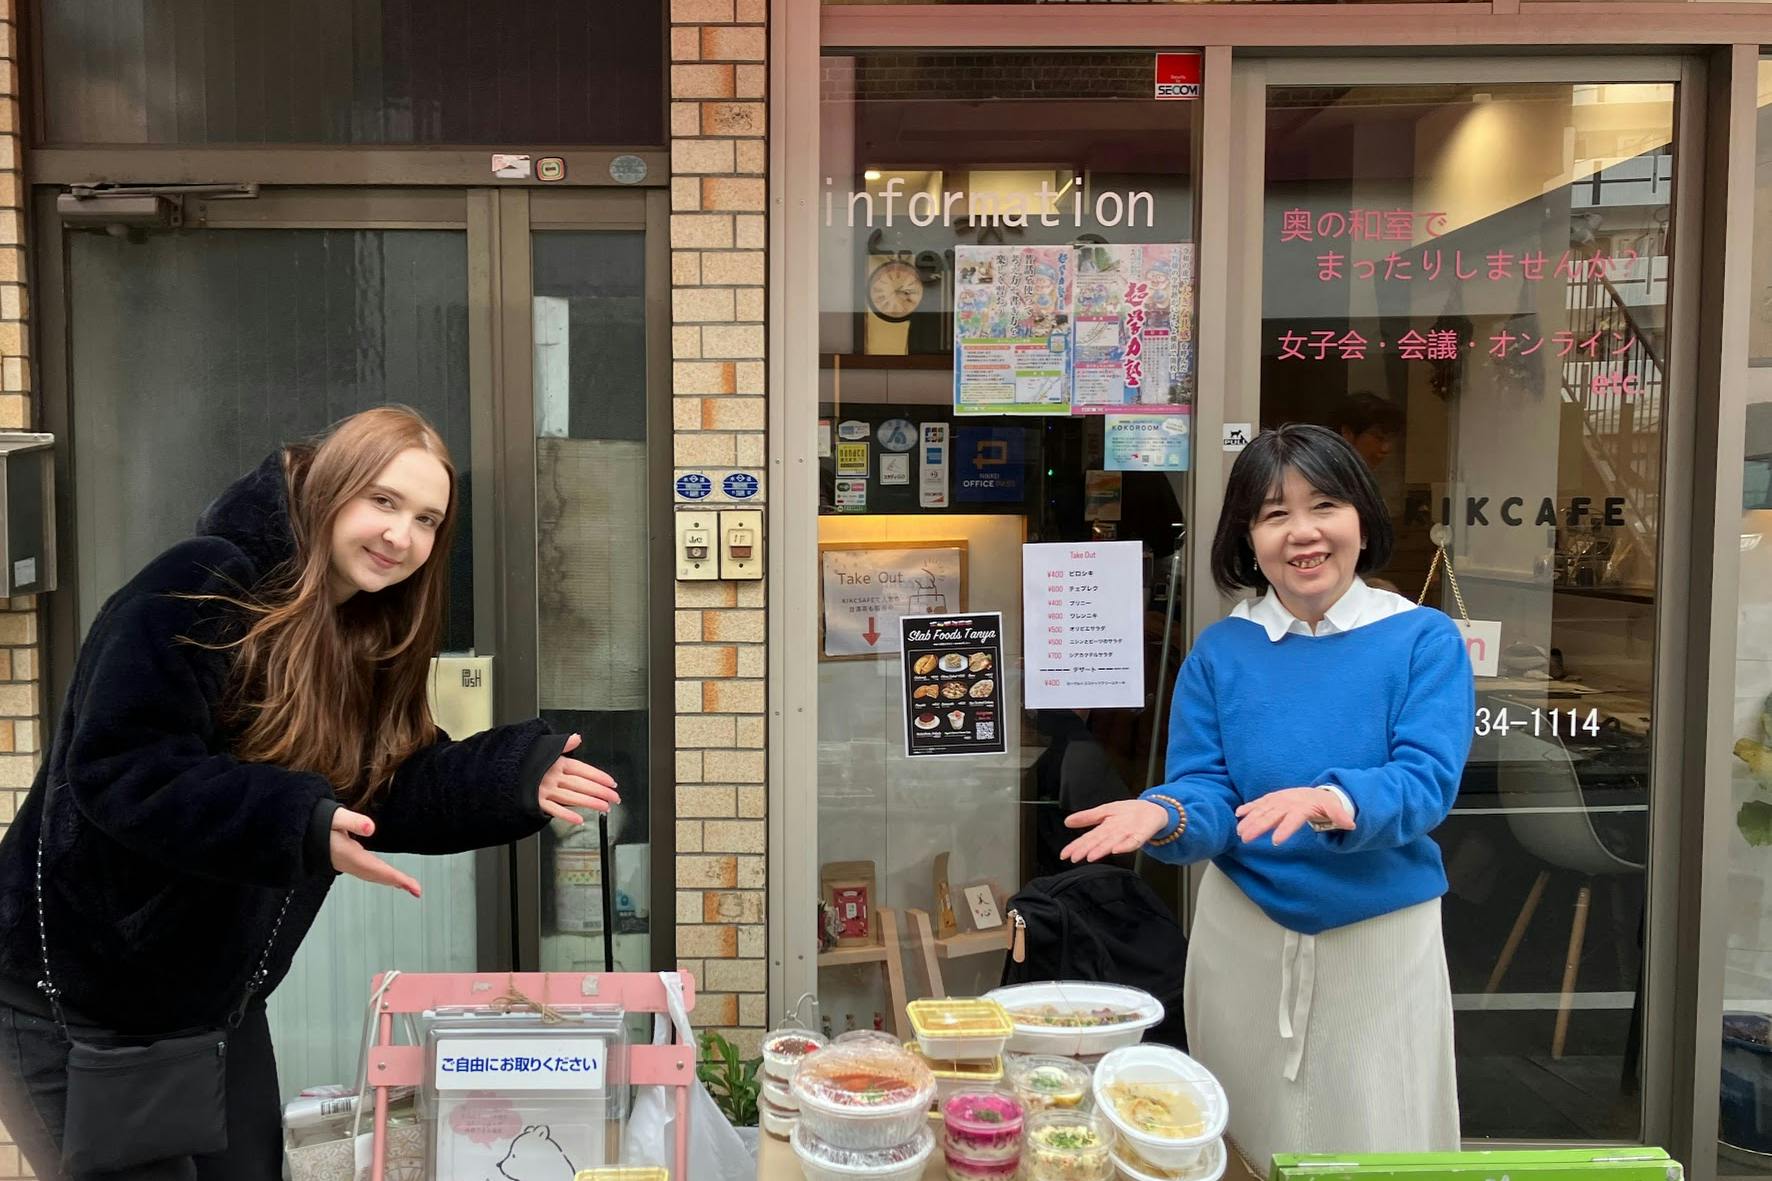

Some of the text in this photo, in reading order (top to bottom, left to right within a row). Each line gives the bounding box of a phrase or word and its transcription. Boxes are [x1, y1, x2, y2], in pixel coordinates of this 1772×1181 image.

[1158, 85, 1198, 95] SECOM
[824, 177, 1154, 227] information
[1280, 208, 1447, 242] 奥の和室で
[1124, 282, 1149, 388] 超学力塾
[1277, 330, 1637, 361] 女子会・会議・オンライン
[963, 480, 995, 488] OFFICE
[1404, 497, 1626, 526] IKCAFE
[1070, 551, 1083, 559] Take
[837, 571, 904, 585] Take Out
[933, 629, 962, 641] Foods
[964, 628, 997, 643] Tanya
[441, 1056, 598, 1073] ご自由にお取りください
